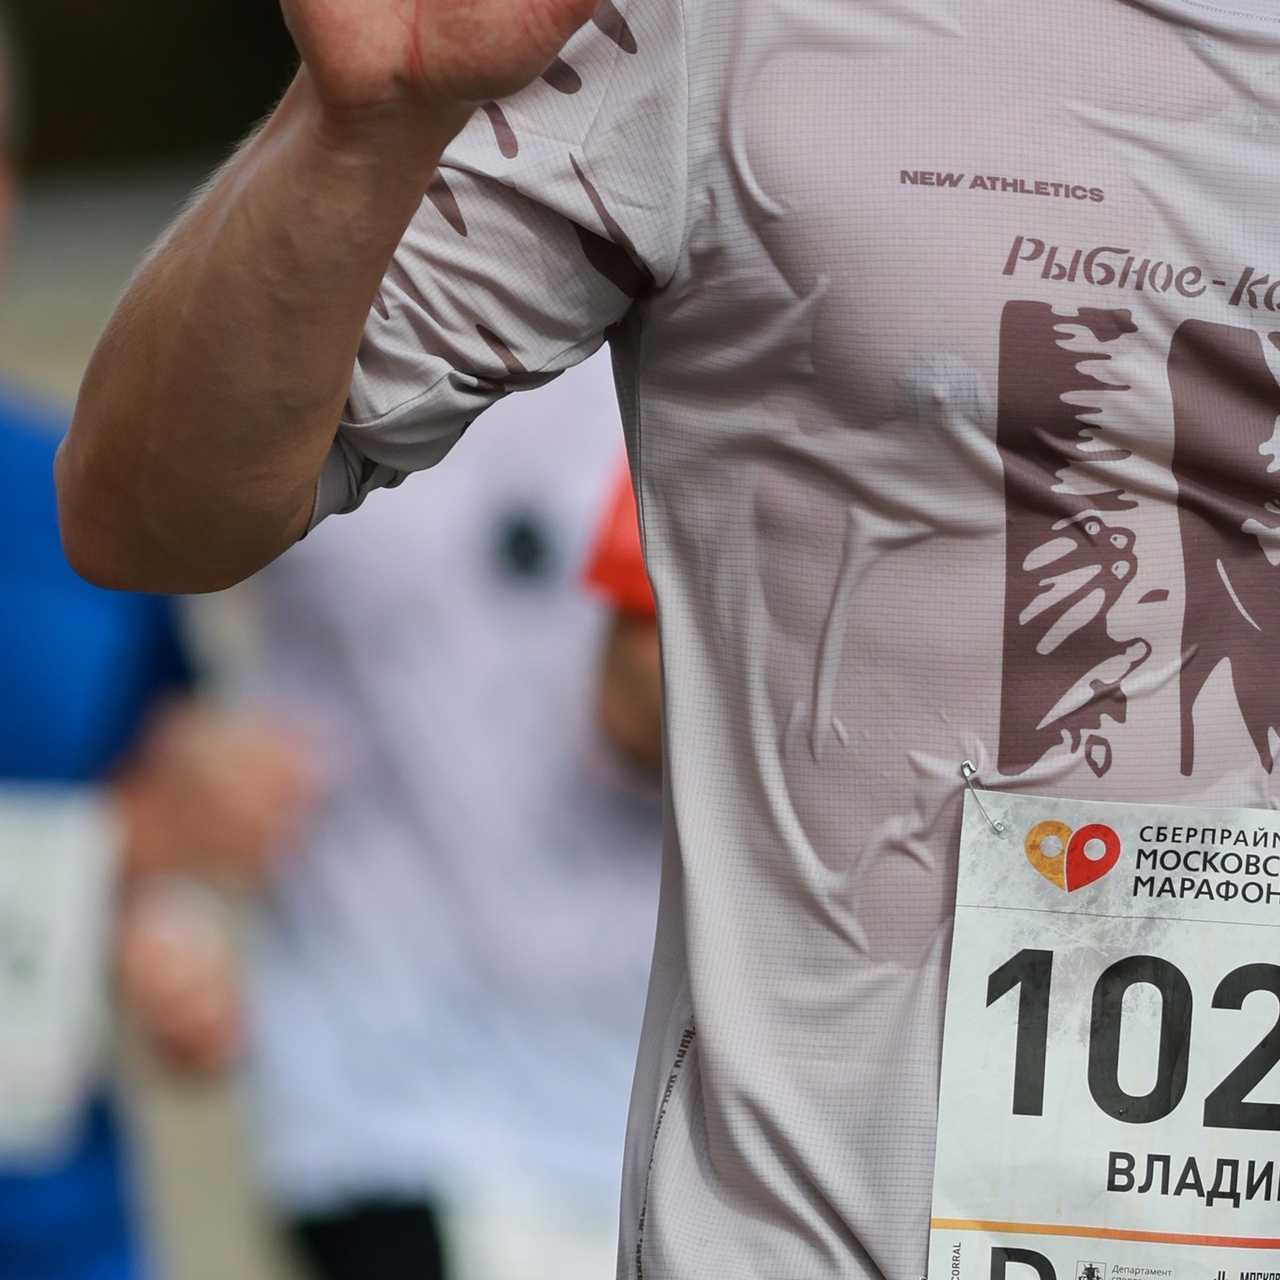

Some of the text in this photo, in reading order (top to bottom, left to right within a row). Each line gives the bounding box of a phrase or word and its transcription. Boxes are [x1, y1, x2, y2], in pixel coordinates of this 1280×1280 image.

[900, 170, 1105, 203] NEW ATHLETICS
[1112, 1264, 1173, 1277] Департамент
